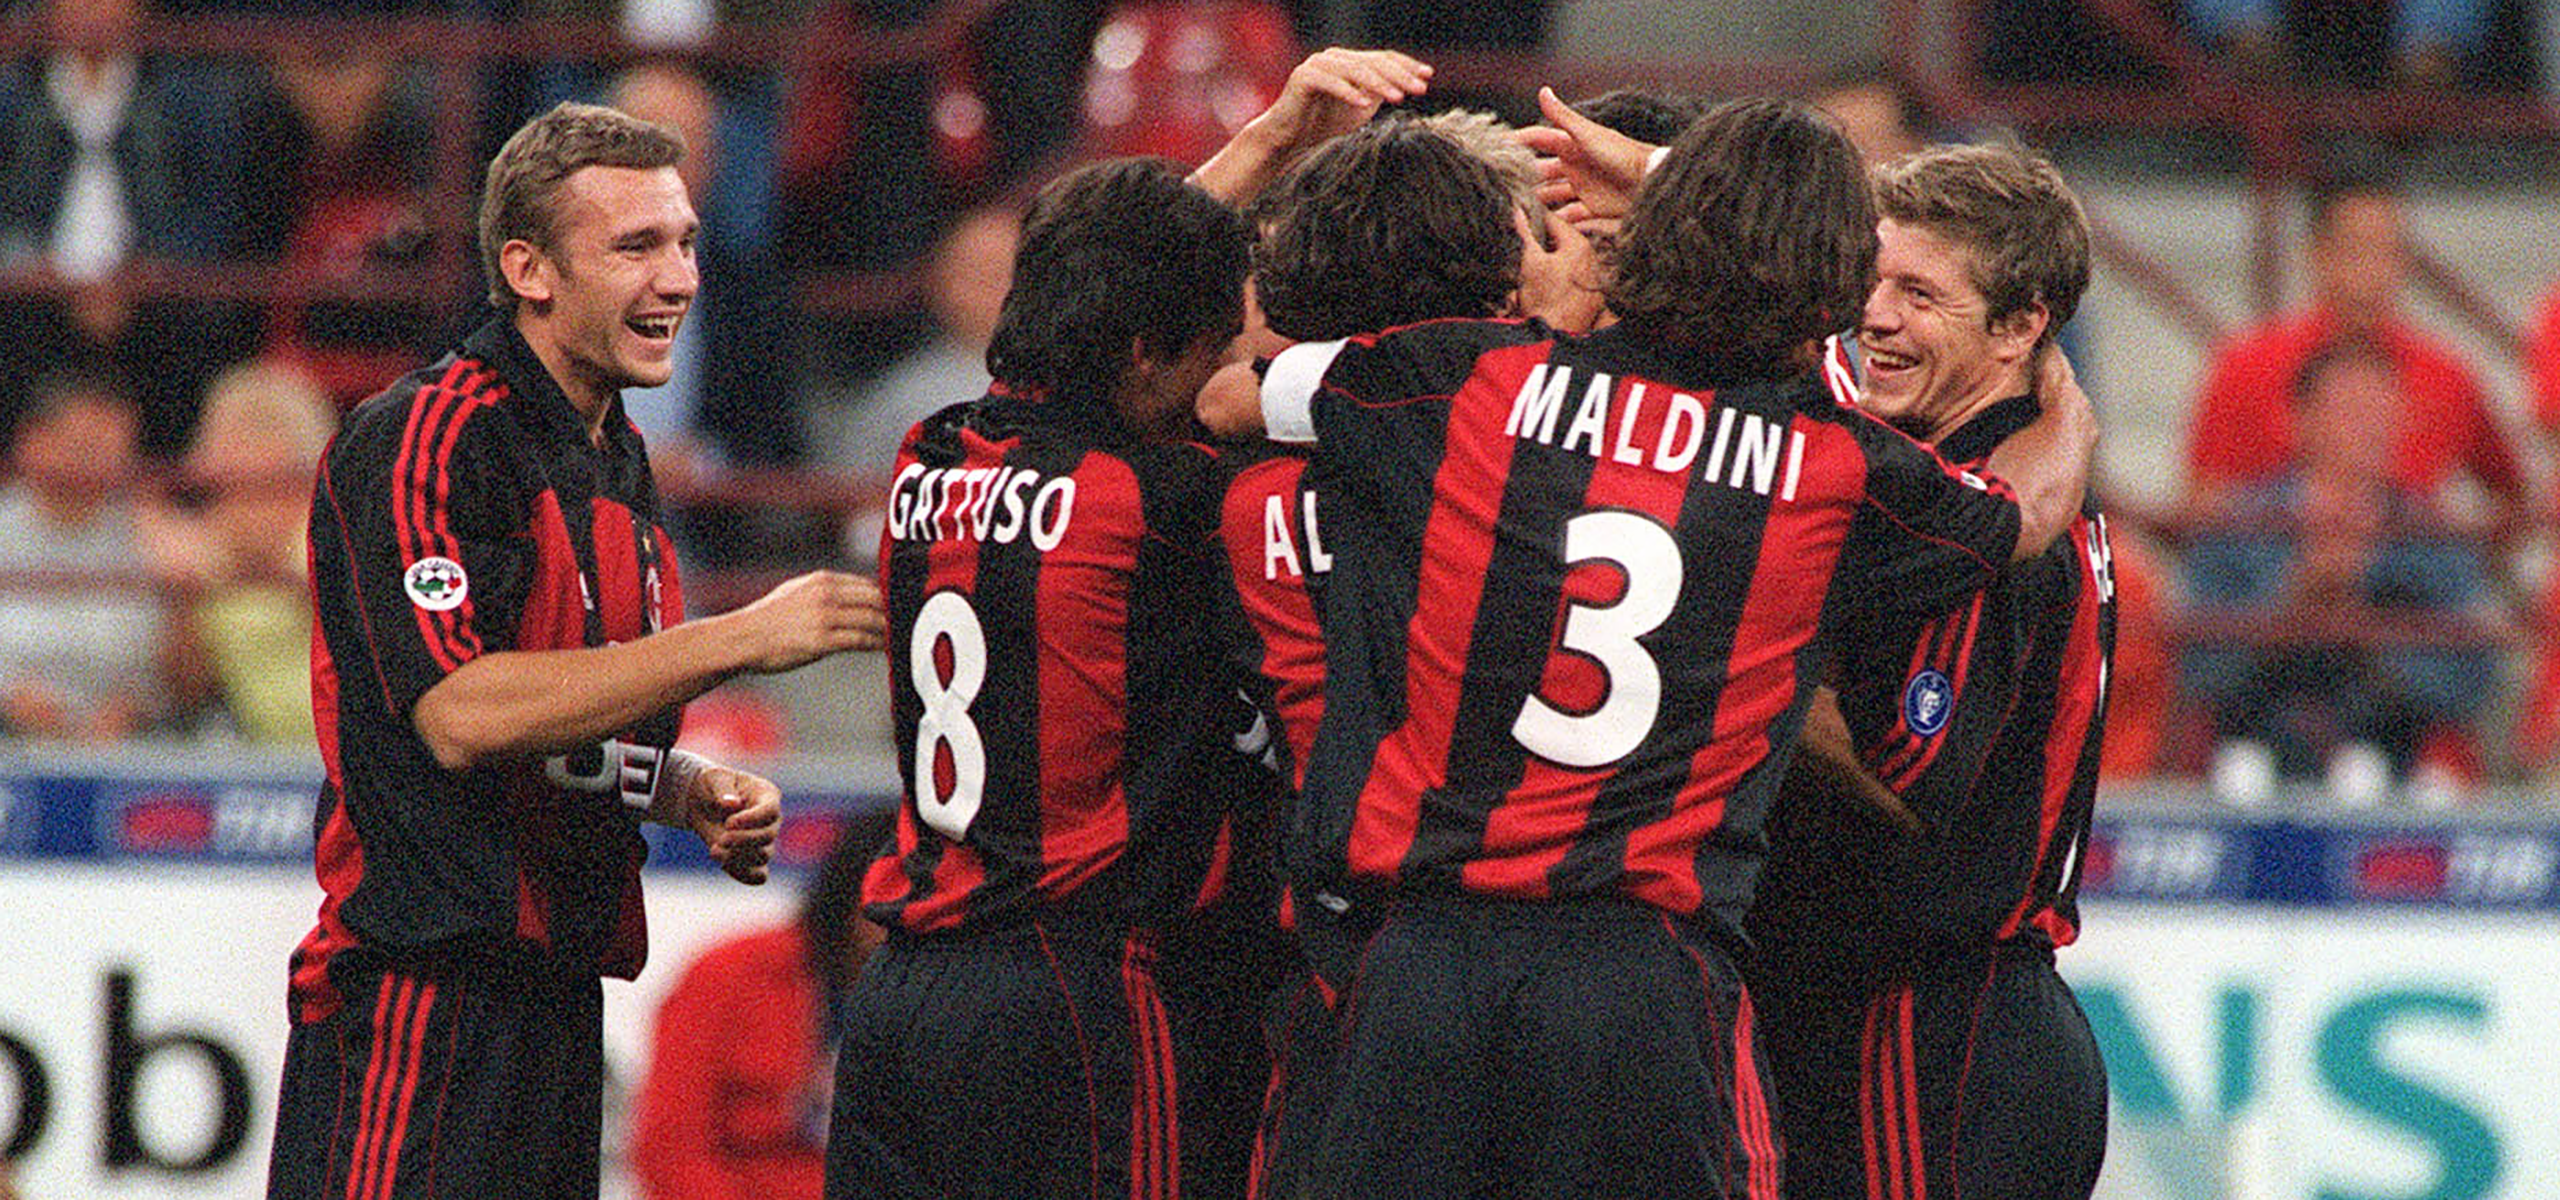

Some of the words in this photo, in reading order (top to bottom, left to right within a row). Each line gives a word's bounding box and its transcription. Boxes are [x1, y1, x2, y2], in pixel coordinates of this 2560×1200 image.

[888, 462, 1077, 552] GATTUSO
[1504, 362, 1806, 502] MALDINI
[910, 591, 988, 841] 8
[1510, 510, 1684, 768] 3
